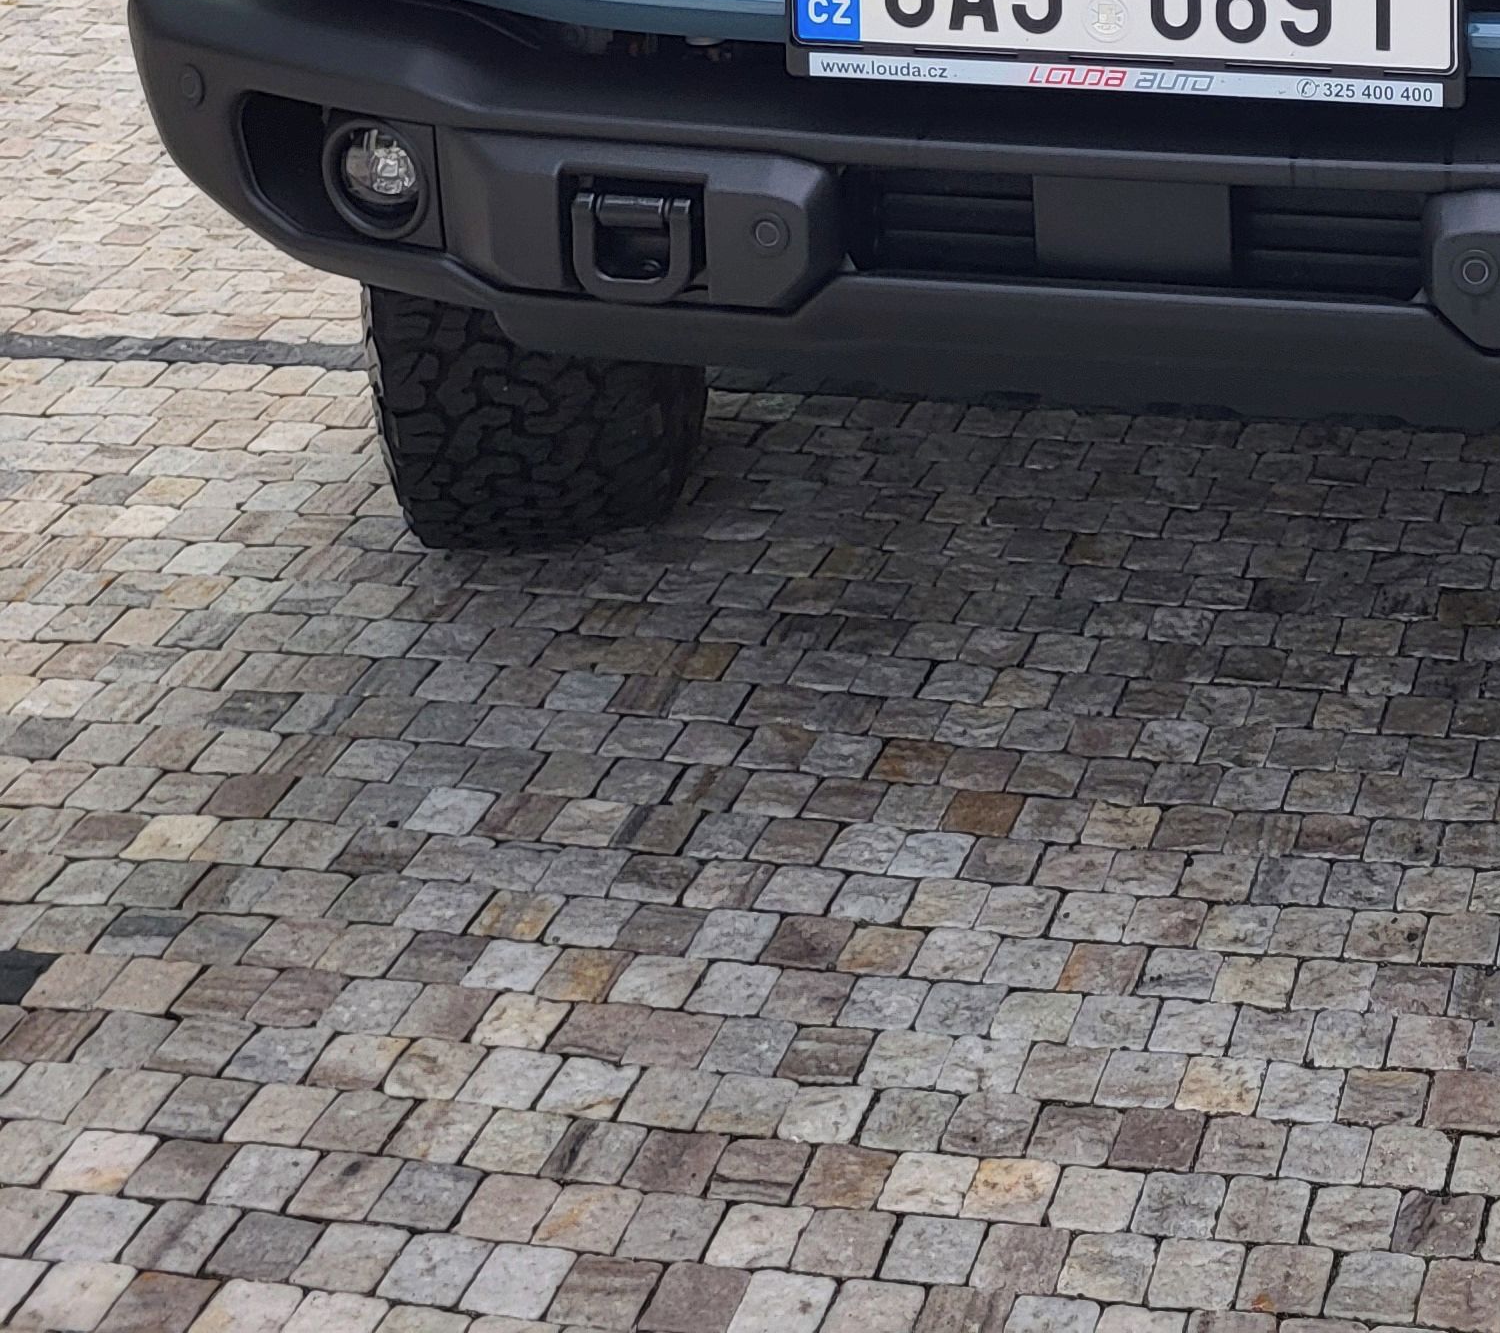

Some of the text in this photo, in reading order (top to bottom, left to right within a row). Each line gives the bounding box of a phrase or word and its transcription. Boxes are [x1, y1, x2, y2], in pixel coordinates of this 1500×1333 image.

[820, 58, 948, 79] www.louda.cz
[1322, 82, 1434, 104] 325 400 400
